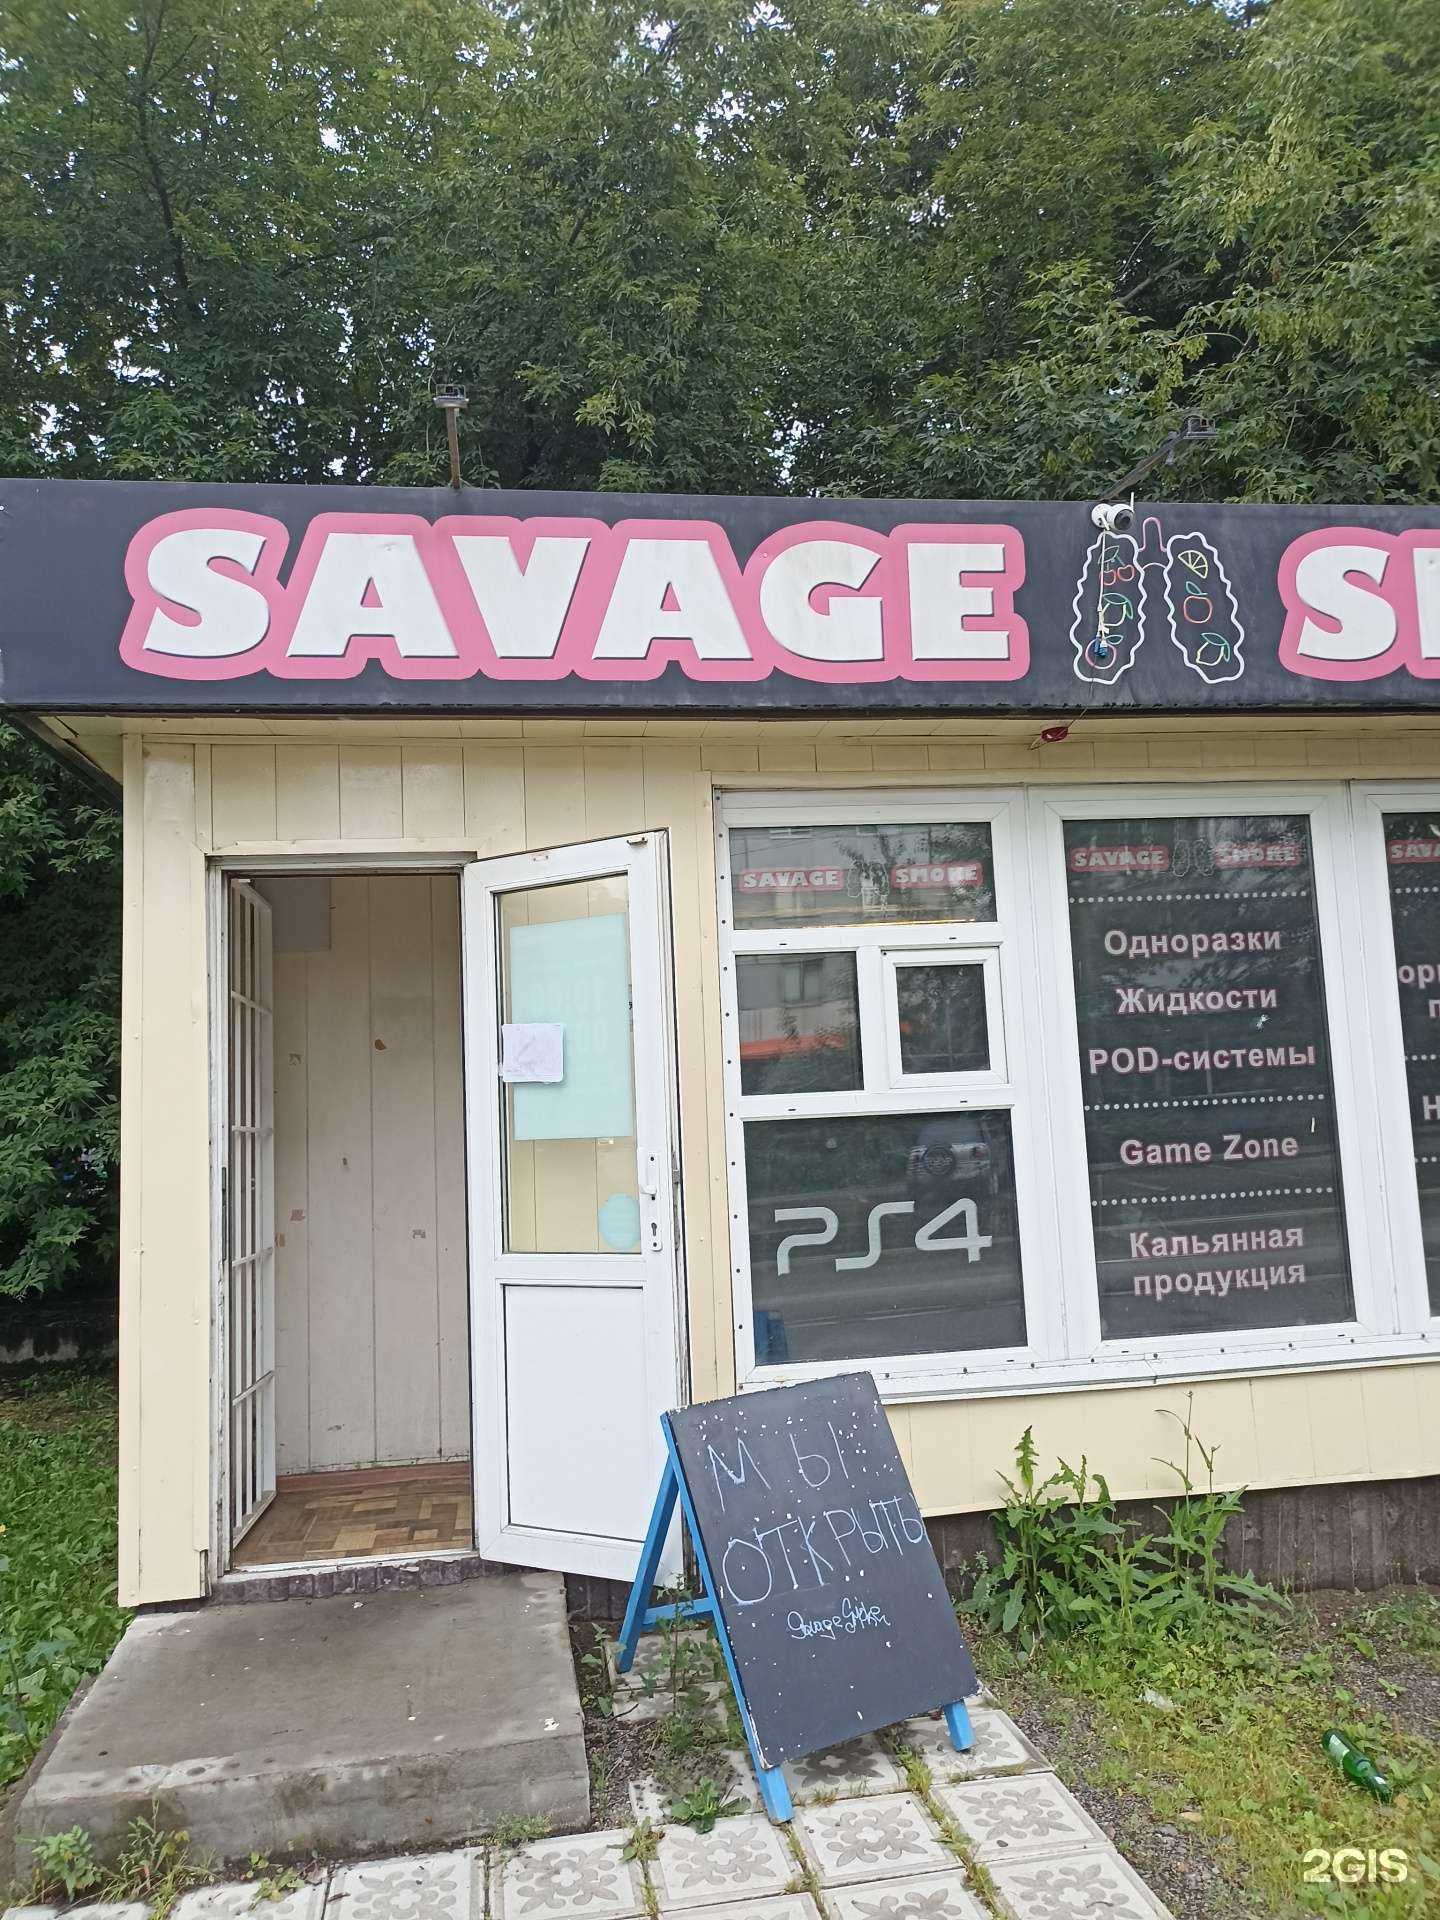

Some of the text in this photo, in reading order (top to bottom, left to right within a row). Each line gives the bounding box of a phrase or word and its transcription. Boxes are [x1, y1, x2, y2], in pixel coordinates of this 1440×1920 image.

[142, 527, 1011, 662] SAVAGE
[1074, 844, 1297, 867] SAVAGE SMOKE
[743, 865, 977, 888] SAVAGE SMOKE
[1103, 929, 1282, 957] Одноразки
[1116, 985, 1278, 1016] Жидкости
[1088, 1045, 1316, 1075] POD-системы
[1119, 1134, 1299, 1166] Game Zone
[774, 1197, 993, 1276] PS4
[1129, 1226, 1305, 1259] Кальянная
[1132, 1262, 1307, 1297] продукция
[706, 1421, 850, 1513] МЫ
